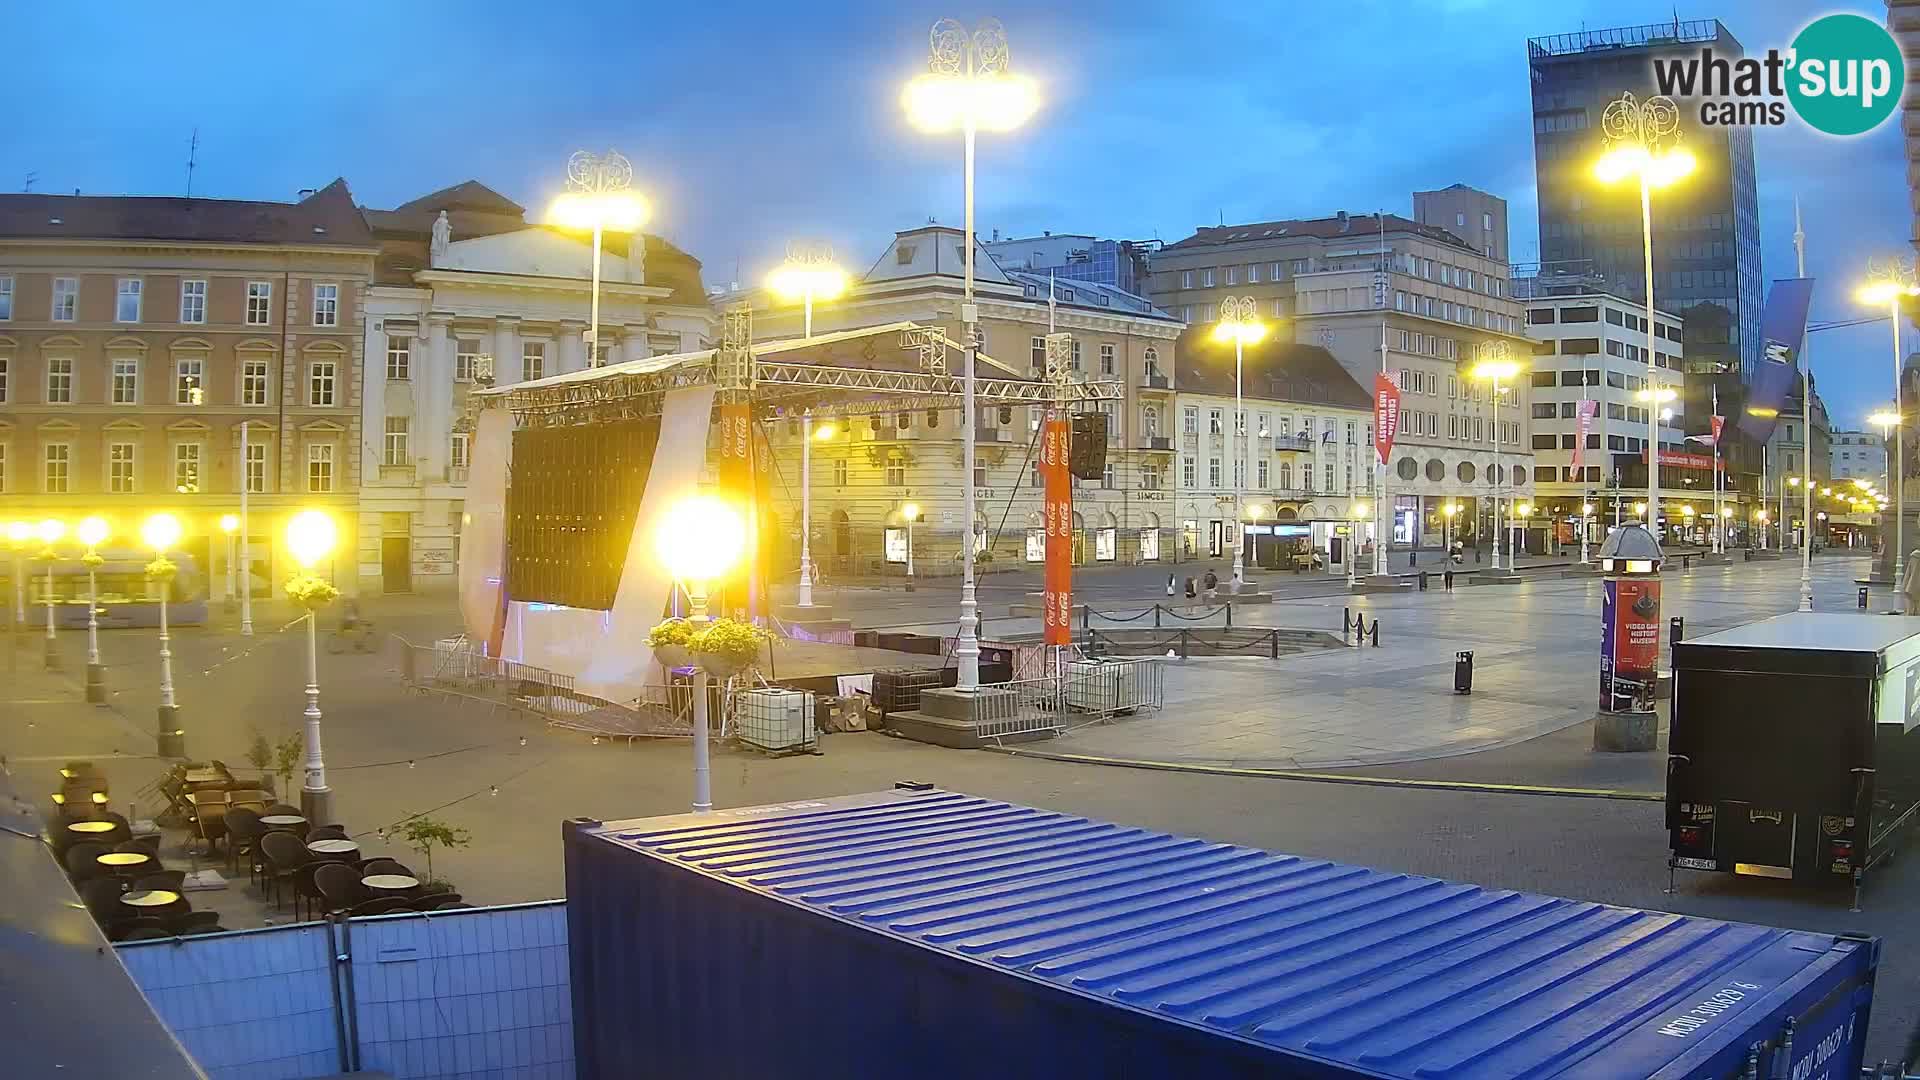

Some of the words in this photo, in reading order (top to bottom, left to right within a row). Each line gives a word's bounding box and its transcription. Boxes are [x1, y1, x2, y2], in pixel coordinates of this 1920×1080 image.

[1379, 410, 1387, 443] EMBASSY
[1388, 398, 1396, 436] CROATIAN
[960, 488, 995, 498] SGER
[1137, 492, 1164, 500] SINGER
[1690, 988, 1745, 1017] 300629
